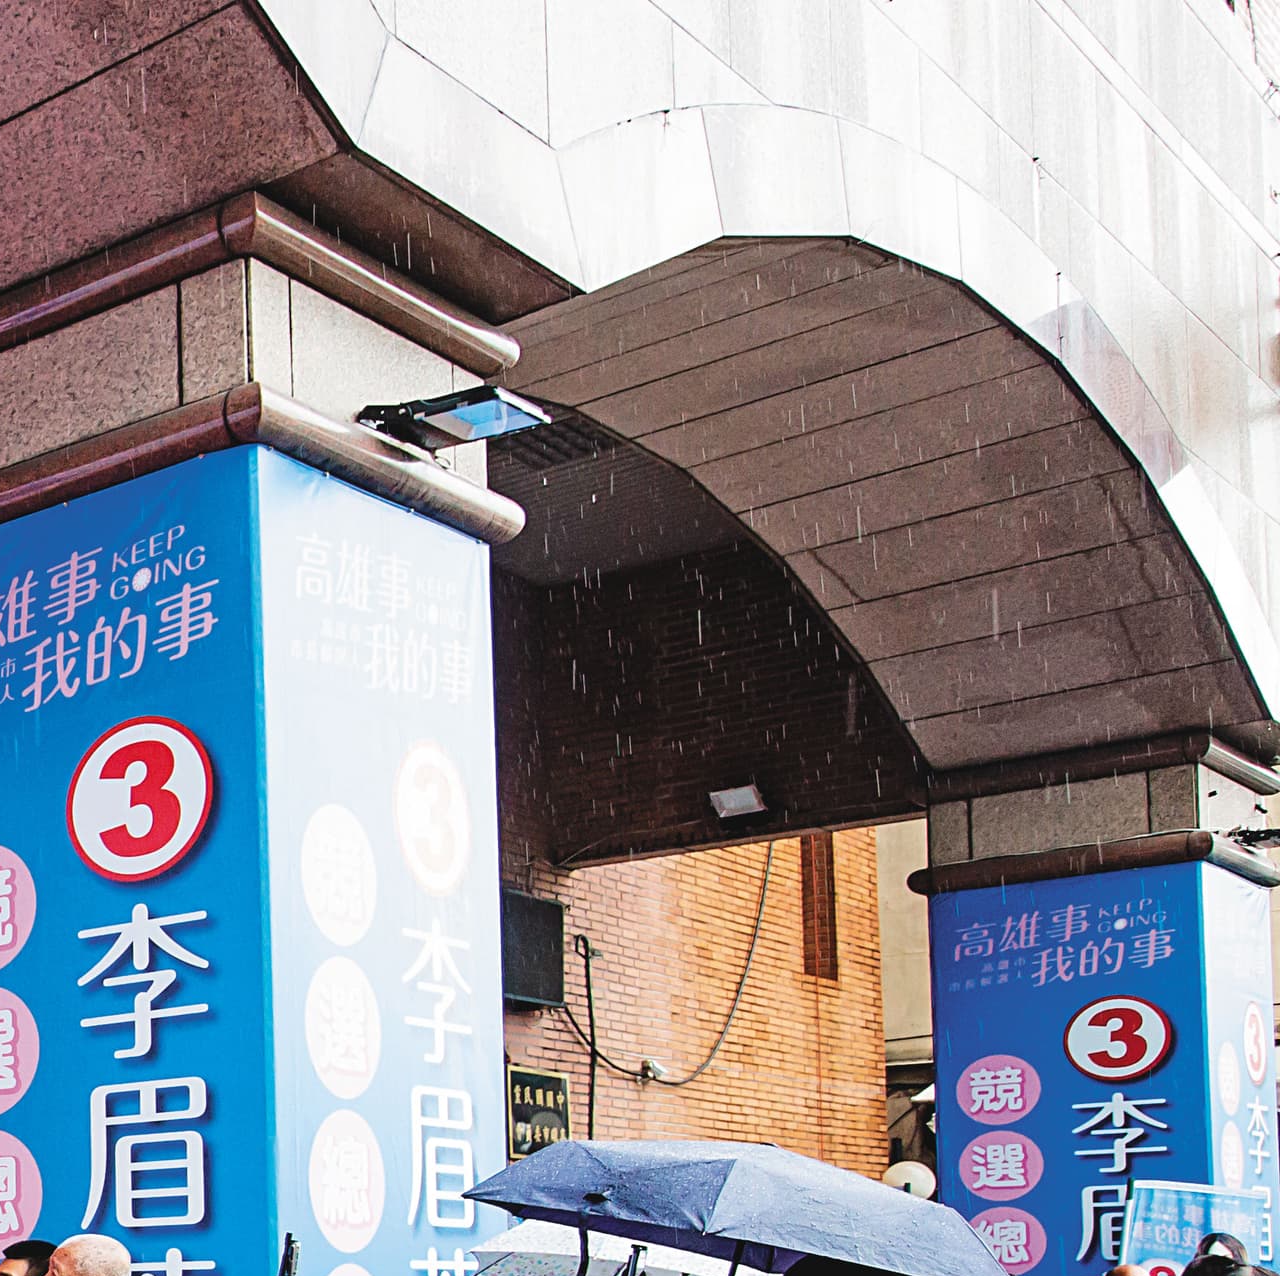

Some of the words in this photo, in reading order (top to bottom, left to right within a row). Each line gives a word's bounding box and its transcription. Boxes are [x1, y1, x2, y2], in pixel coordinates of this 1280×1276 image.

[110, 525, 186, 573] KEEP
[21, 578, 220, 713] 我的事
[99, 739, 183, 858] 3
[954, 904, 1091, 962] 高雄事
[1031, 928, 1177, 988] 我的事
[1086, 1007, 1149, 1069] 3
